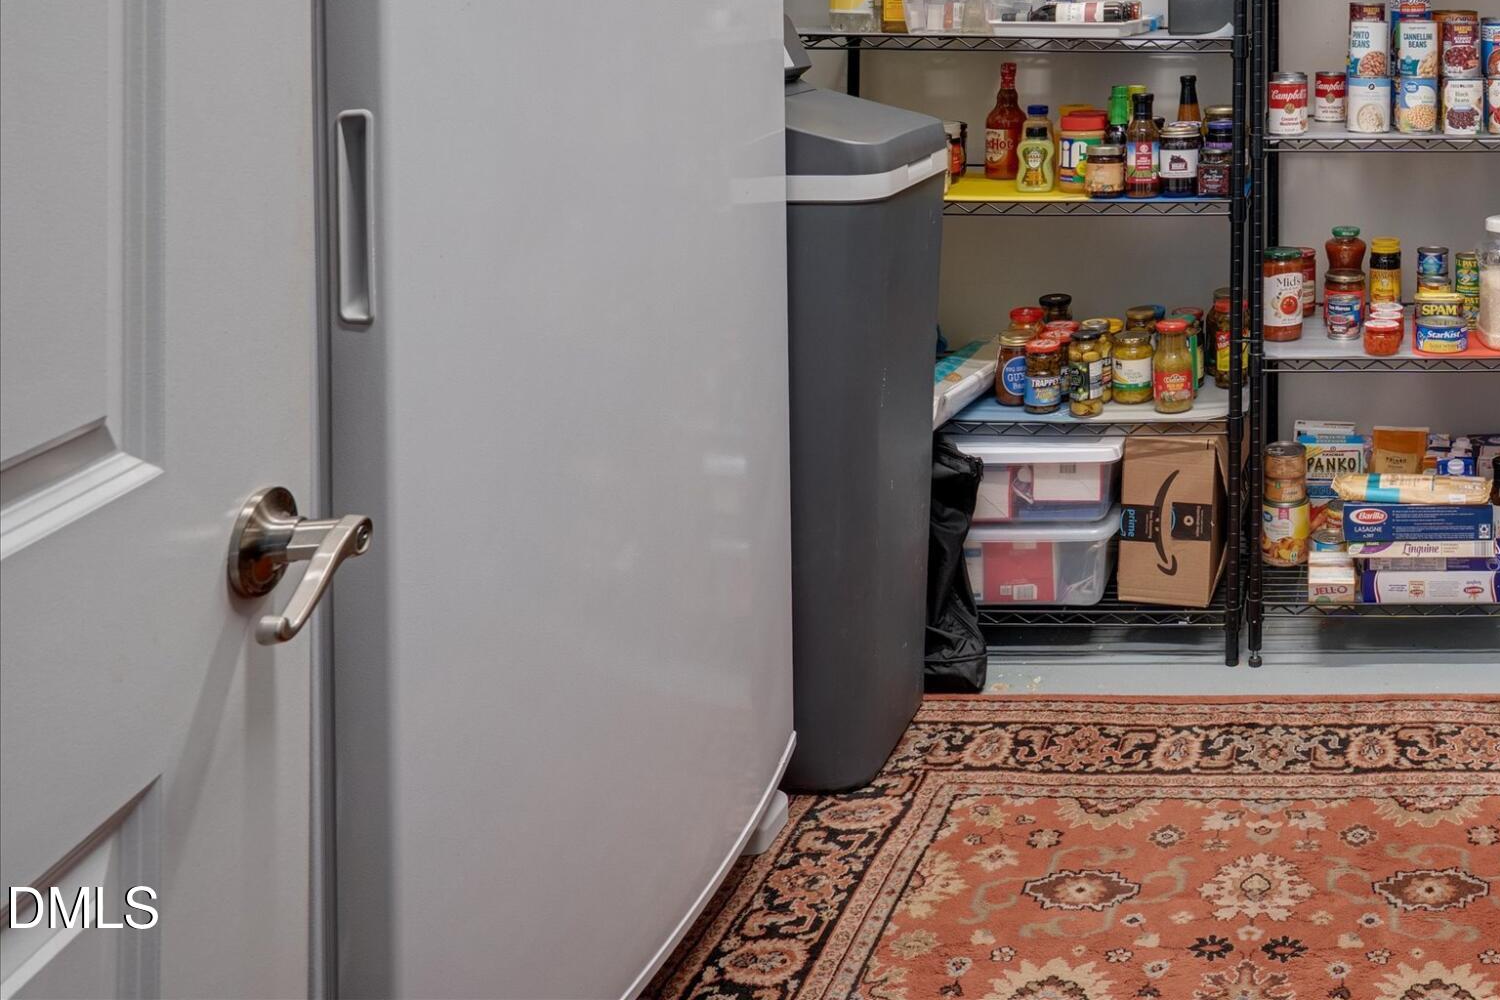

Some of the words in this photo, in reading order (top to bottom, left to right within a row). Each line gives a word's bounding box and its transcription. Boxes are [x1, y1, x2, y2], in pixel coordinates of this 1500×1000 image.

[1353, 31, 1370, 39] PINTO
[1352, 40, 1371, 49] BEANS
[1408, 41, 1427, 49] BEANS
[1422, 304, 1457, 316] SPAM
[1427, 330, 1461, 339] StarKist
[1307, 457, 1357, 471] PANKO
[1359, 512, 1385, 520] Barilla
[1127, 508, 1137, 537] prime
[1402, 543, 1440, 557] Linguine
[1314, 585, 1348, 596] JELL-O
